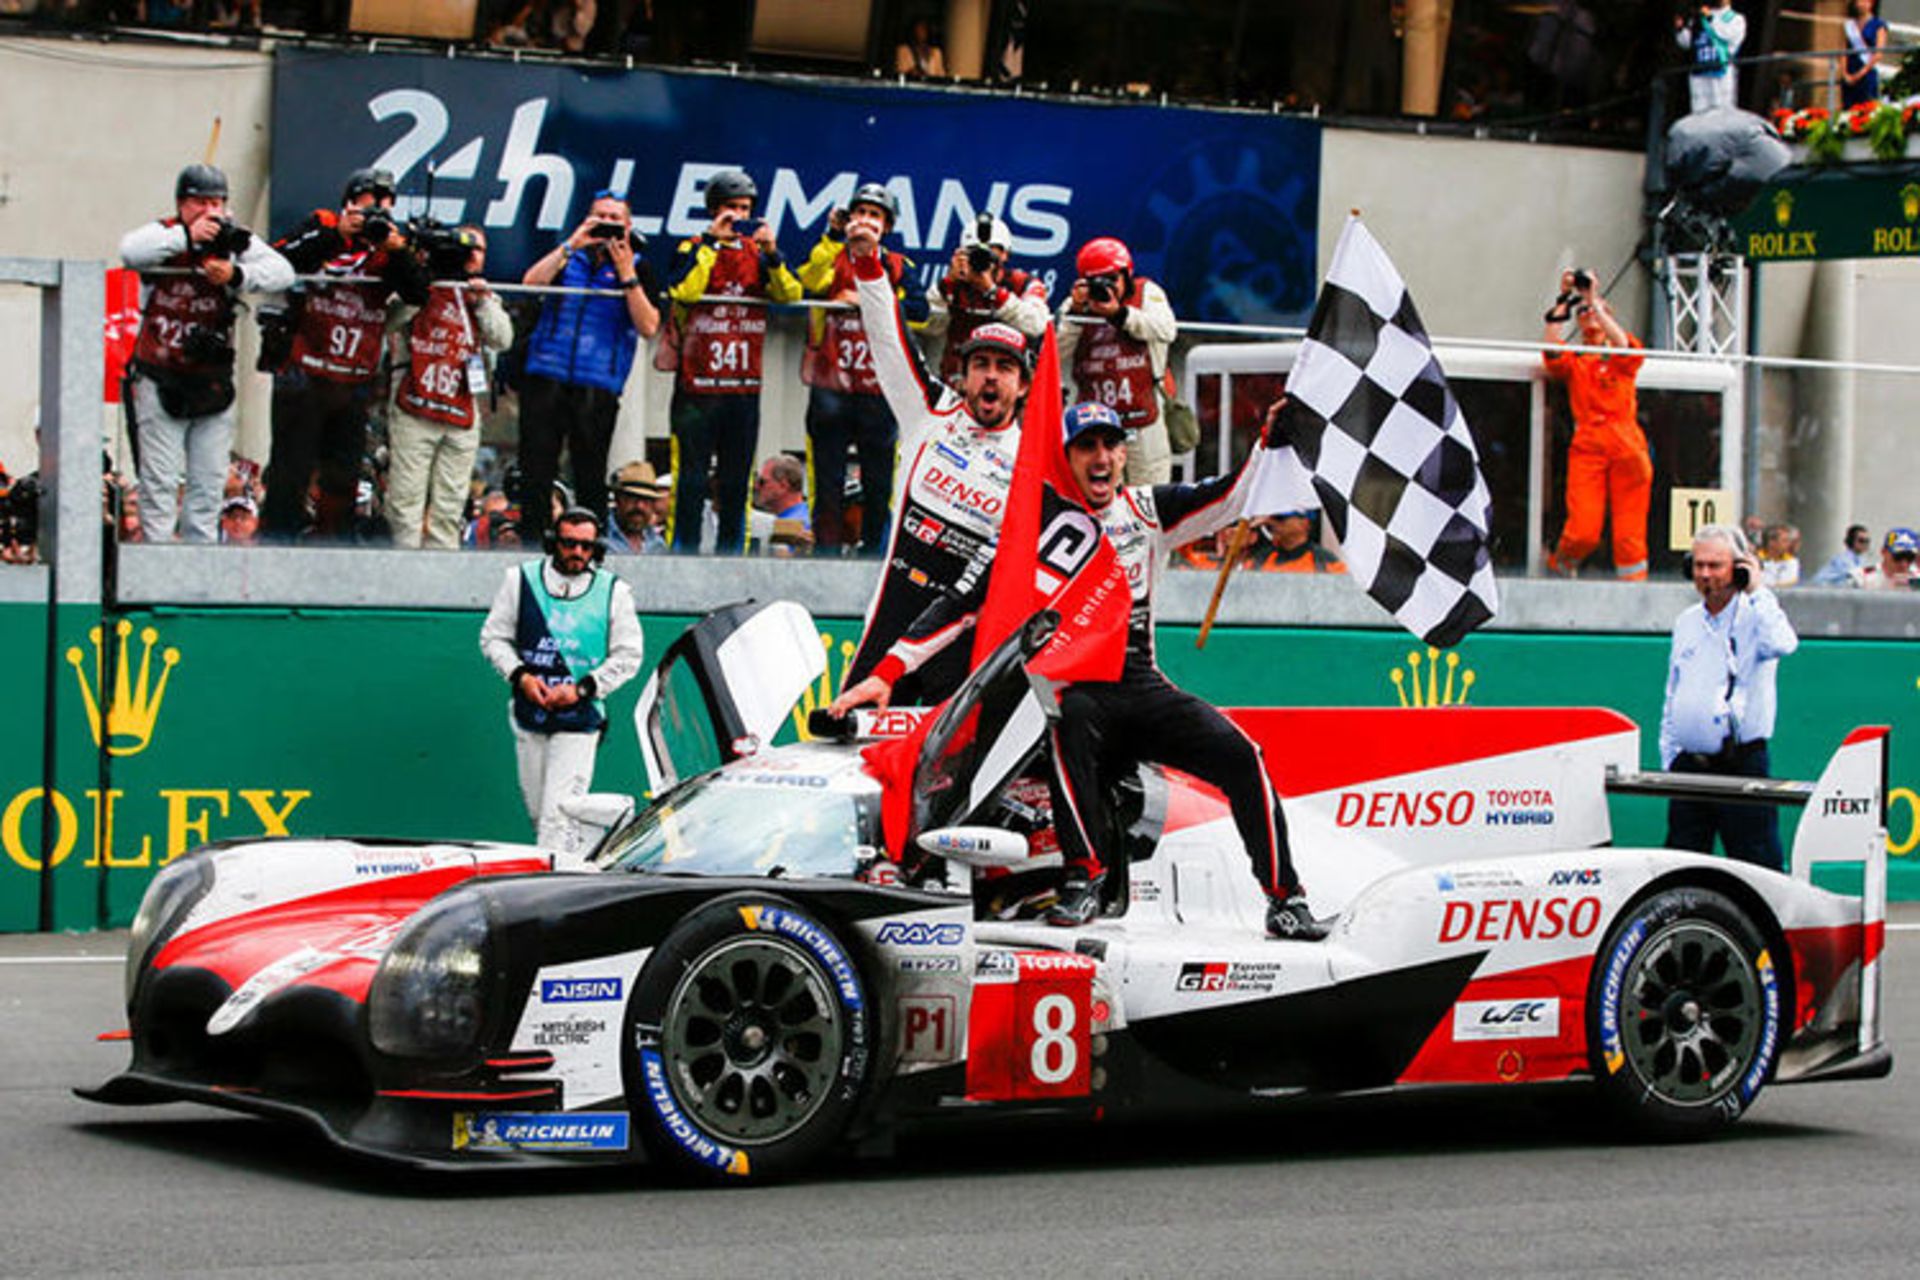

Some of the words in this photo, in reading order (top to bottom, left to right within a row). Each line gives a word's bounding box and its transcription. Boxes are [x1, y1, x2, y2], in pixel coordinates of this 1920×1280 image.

[1749, 231, 1817, 257] ROLEX
[330, 325, 363, 358] 97
[709, 341, 749, 371] 341
[924, 466, 1002, 516] DENSO
[1336, 790, 1476, 828] DENSO
[1487, 789, 1554, 807] TOYOTA
[1822, 798, 1871, 817] JTEKT
[1486, 811, 1555, 826] HYBRID
[1438, 897, 1602, 944] DENSO
[876, 922, 966, 945] RAYS
[779, 913, 860, 1000] MICHELIN
[1023, 954, 1092, 970] TOTAL
[547, 982, 618, 999] AISIN
[1179, 971, 1223, 991] GR
[1604, 928, 1642, 1031] MICHELIN
[1480, 1002, 1547, 1024] WEC
[541, 1020, 605, 1033] MITSUBISHI
[905, 1006, 945, 1052] P1
[1030, 993, 1078, 1084] 8
[534, 1033, 590, 1046] ELECTRIC
[646, 1060, 712, 1160] MICHELIN
[504, 1124, 616, 1140] MICHELIN
